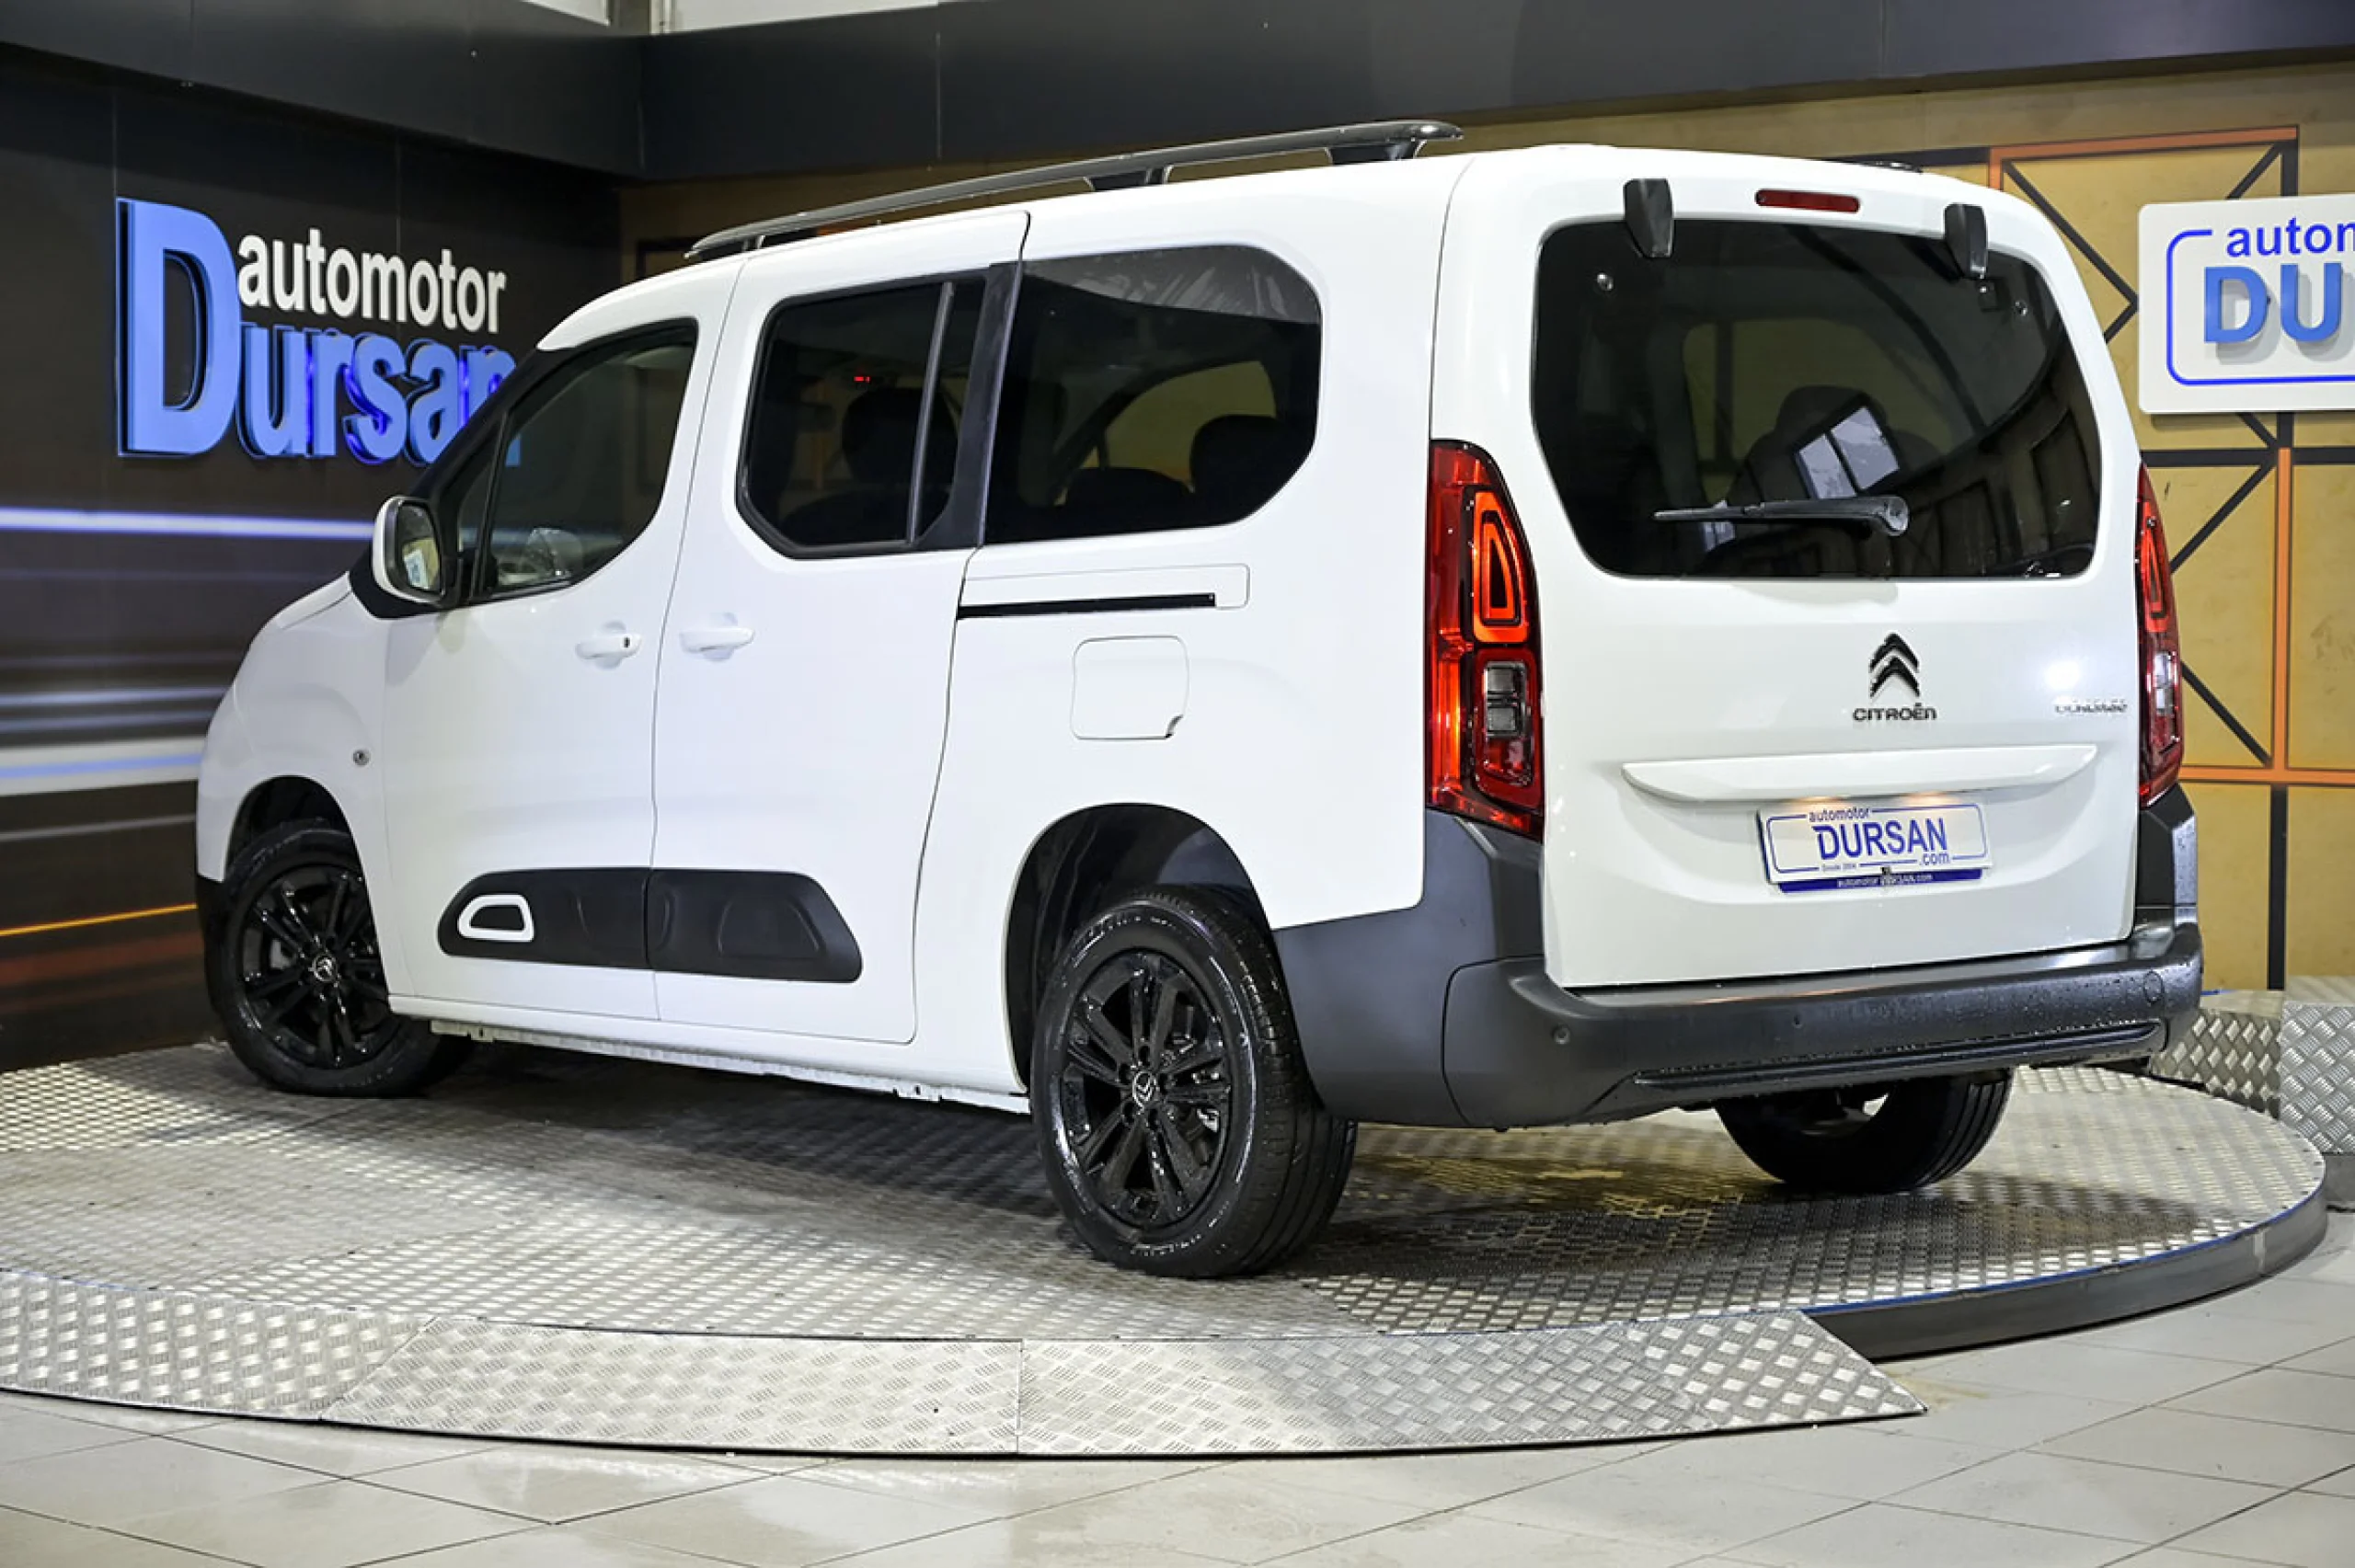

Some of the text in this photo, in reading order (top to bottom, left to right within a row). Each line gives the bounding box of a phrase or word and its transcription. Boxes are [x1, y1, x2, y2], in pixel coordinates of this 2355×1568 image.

[238, 227, 508, 333] automotor
[1809, 807, 1869, 823] automotor
[1811, 818, 1948, 860] DURSAN
[1919, 852, 1950, 866] .com
